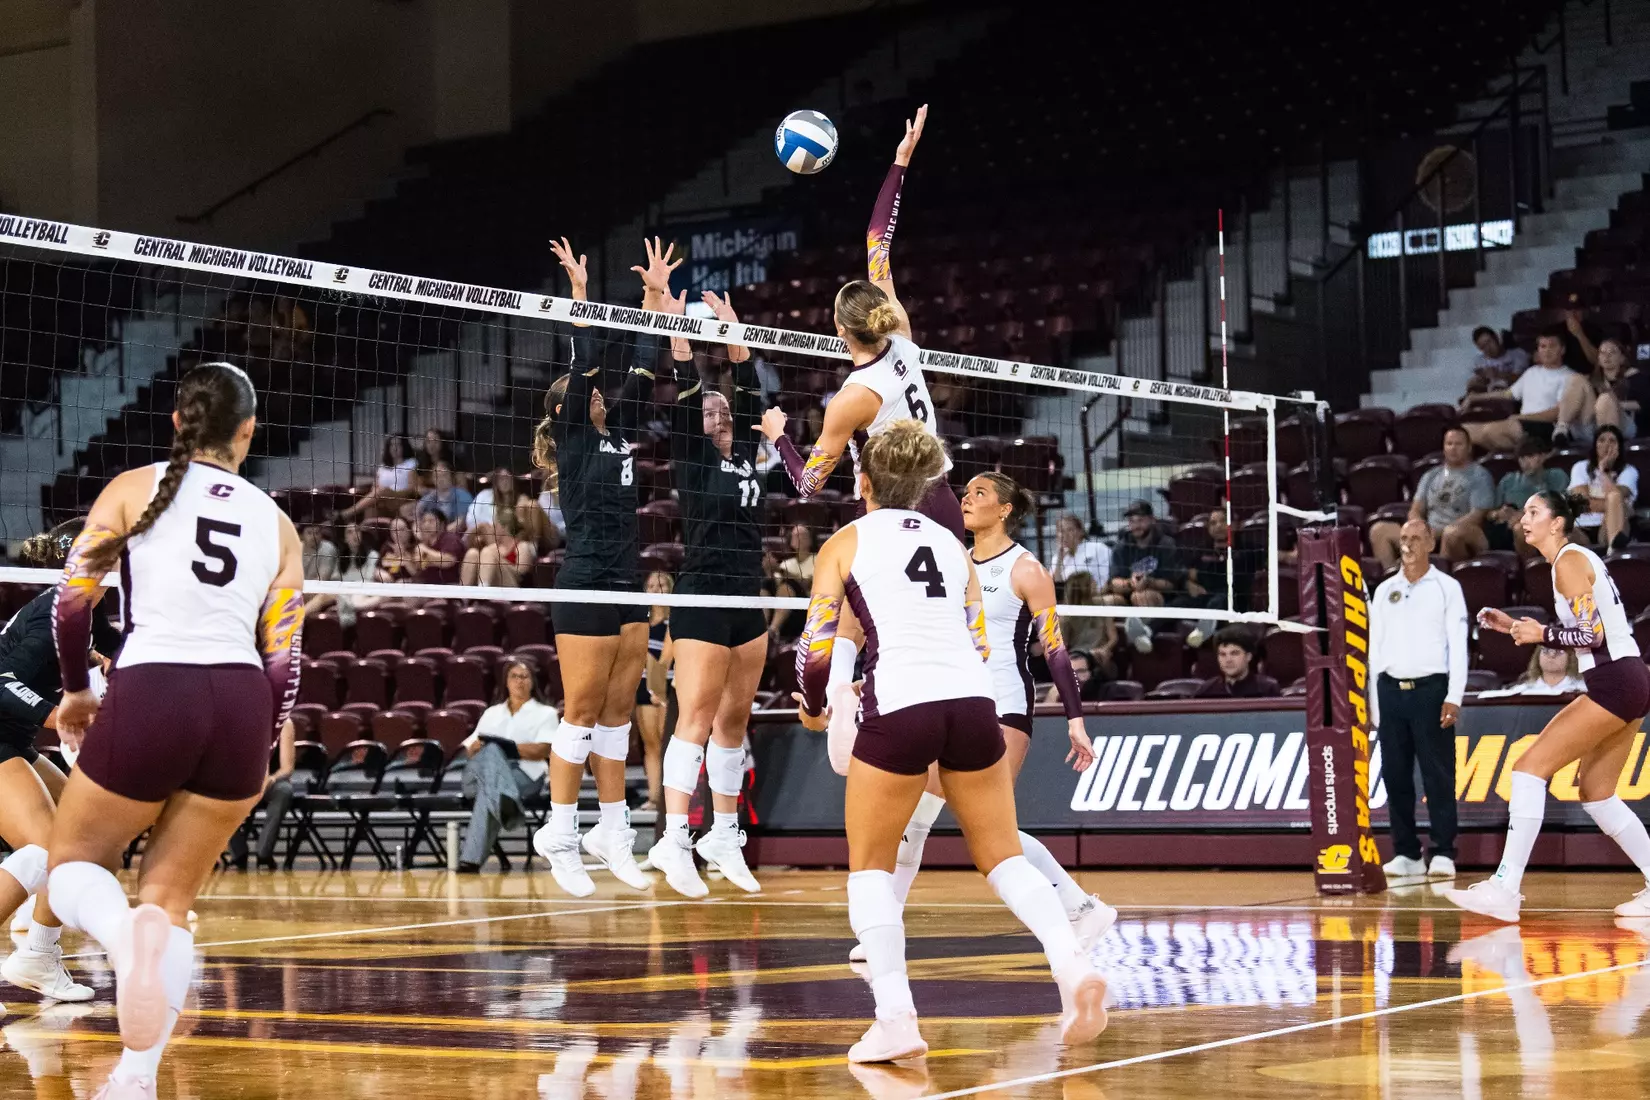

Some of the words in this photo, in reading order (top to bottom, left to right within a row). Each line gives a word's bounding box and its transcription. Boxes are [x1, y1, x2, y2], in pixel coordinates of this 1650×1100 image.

[133, 237, 186, 262] CENTRAL
[187, 243, 246, 270] MICHIGAN
[248, 252, 314, 280] VOLLEYBALL
[368, 271, 413, 294] CENTRAL
[414, 278, 465, 302] MICHIGAN
[466, 286, 522, 311] VOLLEYBALL
[569, 301, 608, 322] CENTRAL
[609, 306, 652, 328] MICHIGAN
[652, 315, 703, 335] VOLLEYBALL
[743, 326, 777, 345] CENTRAL
[778, 332, 817, 350] MICHIGAN
[926, 351, 961, 368] MICHIGAN
[960, 357, 999, 374] VOLLEYBALL
[1030, 365, 1057, 382] CENTRAL
[1057, 370, 1087, 385] MICHIGAN
[1087, 374, 1122, 390] VOLLEYBALL
[904, 383, 928, 424] 6
[1150, 382, 1173, 396] CENTRAL
[1174, 385, 1201, 399] MICHIGAN
[620, 456, 634, 486] 8
[738, 479, 760, 507] 11
[191, 516, 241, 587] 5
[904, 546, 947, 598] 4
[1340, 554, 1380, 866] CHIPPEWAS
[1321, 745, 1336, 785] sports
[1324, 786, 1339, 835] imports
